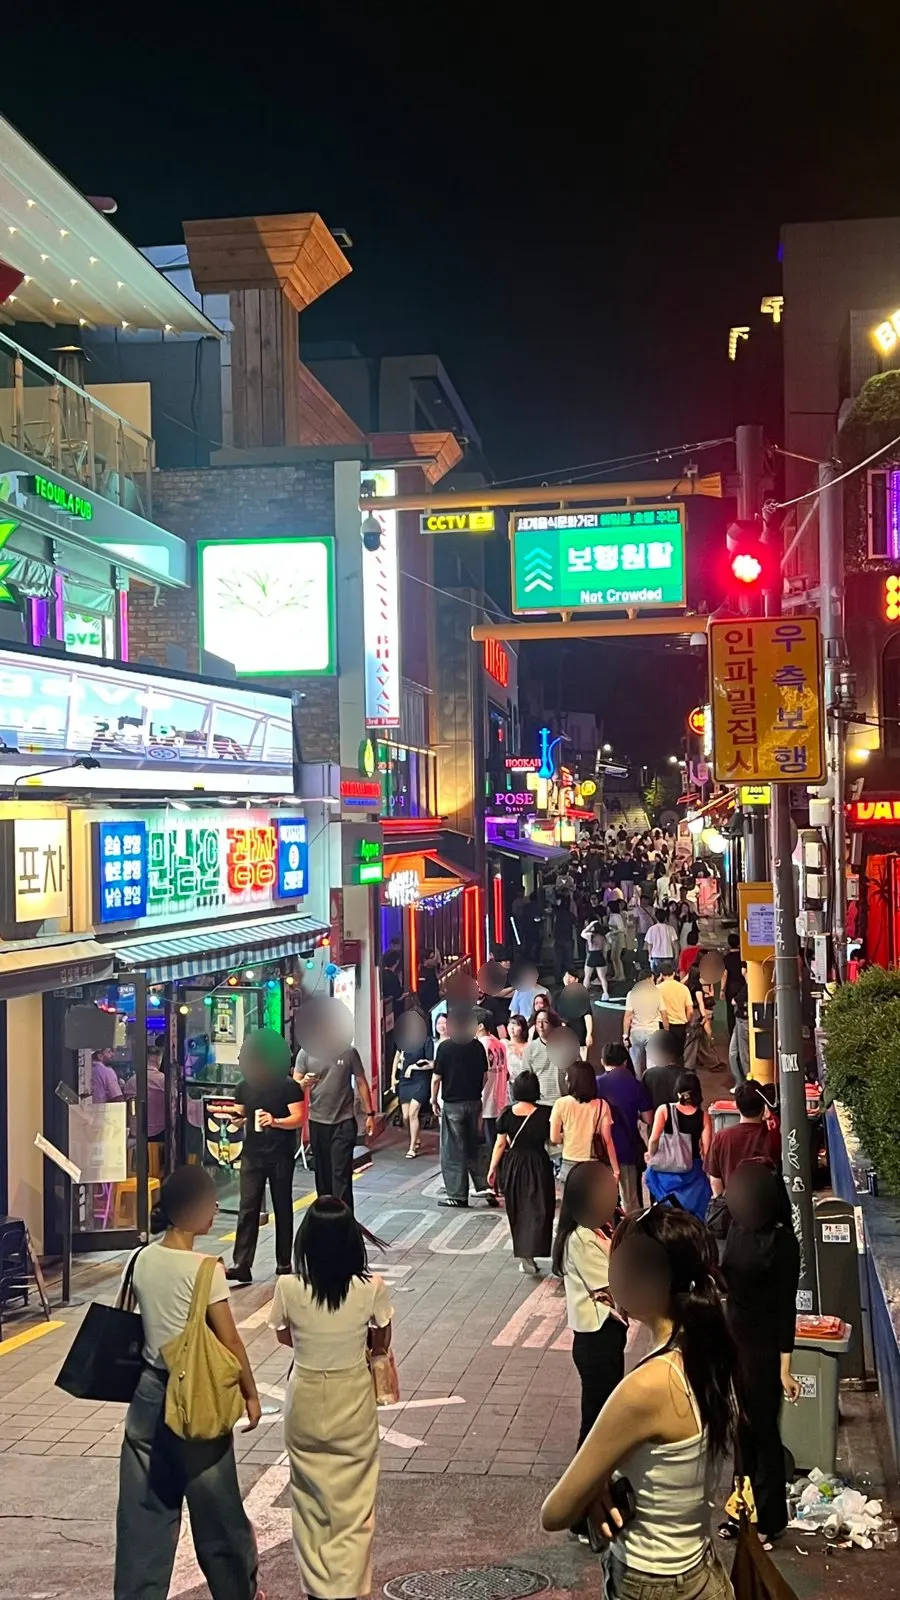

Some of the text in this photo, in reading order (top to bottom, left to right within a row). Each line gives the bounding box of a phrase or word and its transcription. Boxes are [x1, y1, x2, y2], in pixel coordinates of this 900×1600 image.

[34, 475, 92, 520] TEQUILA PUB
[427, 514, 466, 531] CCTV
[517, 514, 598, 530] 세계음식문화거리
[656, 510, 678, 523] 주변
[567, 541, 674, 572] 보행원활
[580, 587, 663, 604] Not Crowded
[376, 635, 390, 715] BHAVAN
[723, 627, 759, 774] 인파밀집시
[771, 625, 808, 774] 우측보행
[366, 717, 400, 726] 3rd Floor
[505, 758, 541, 768] HOOKAH
[495, 793, 534, 805] POSE
[123, 835, 141, 855] 환영
[18, 844, 65, 894] 포차
[123, 860, 141, 880] 환영
[105, 885, 141, 908] 낮술 환영
